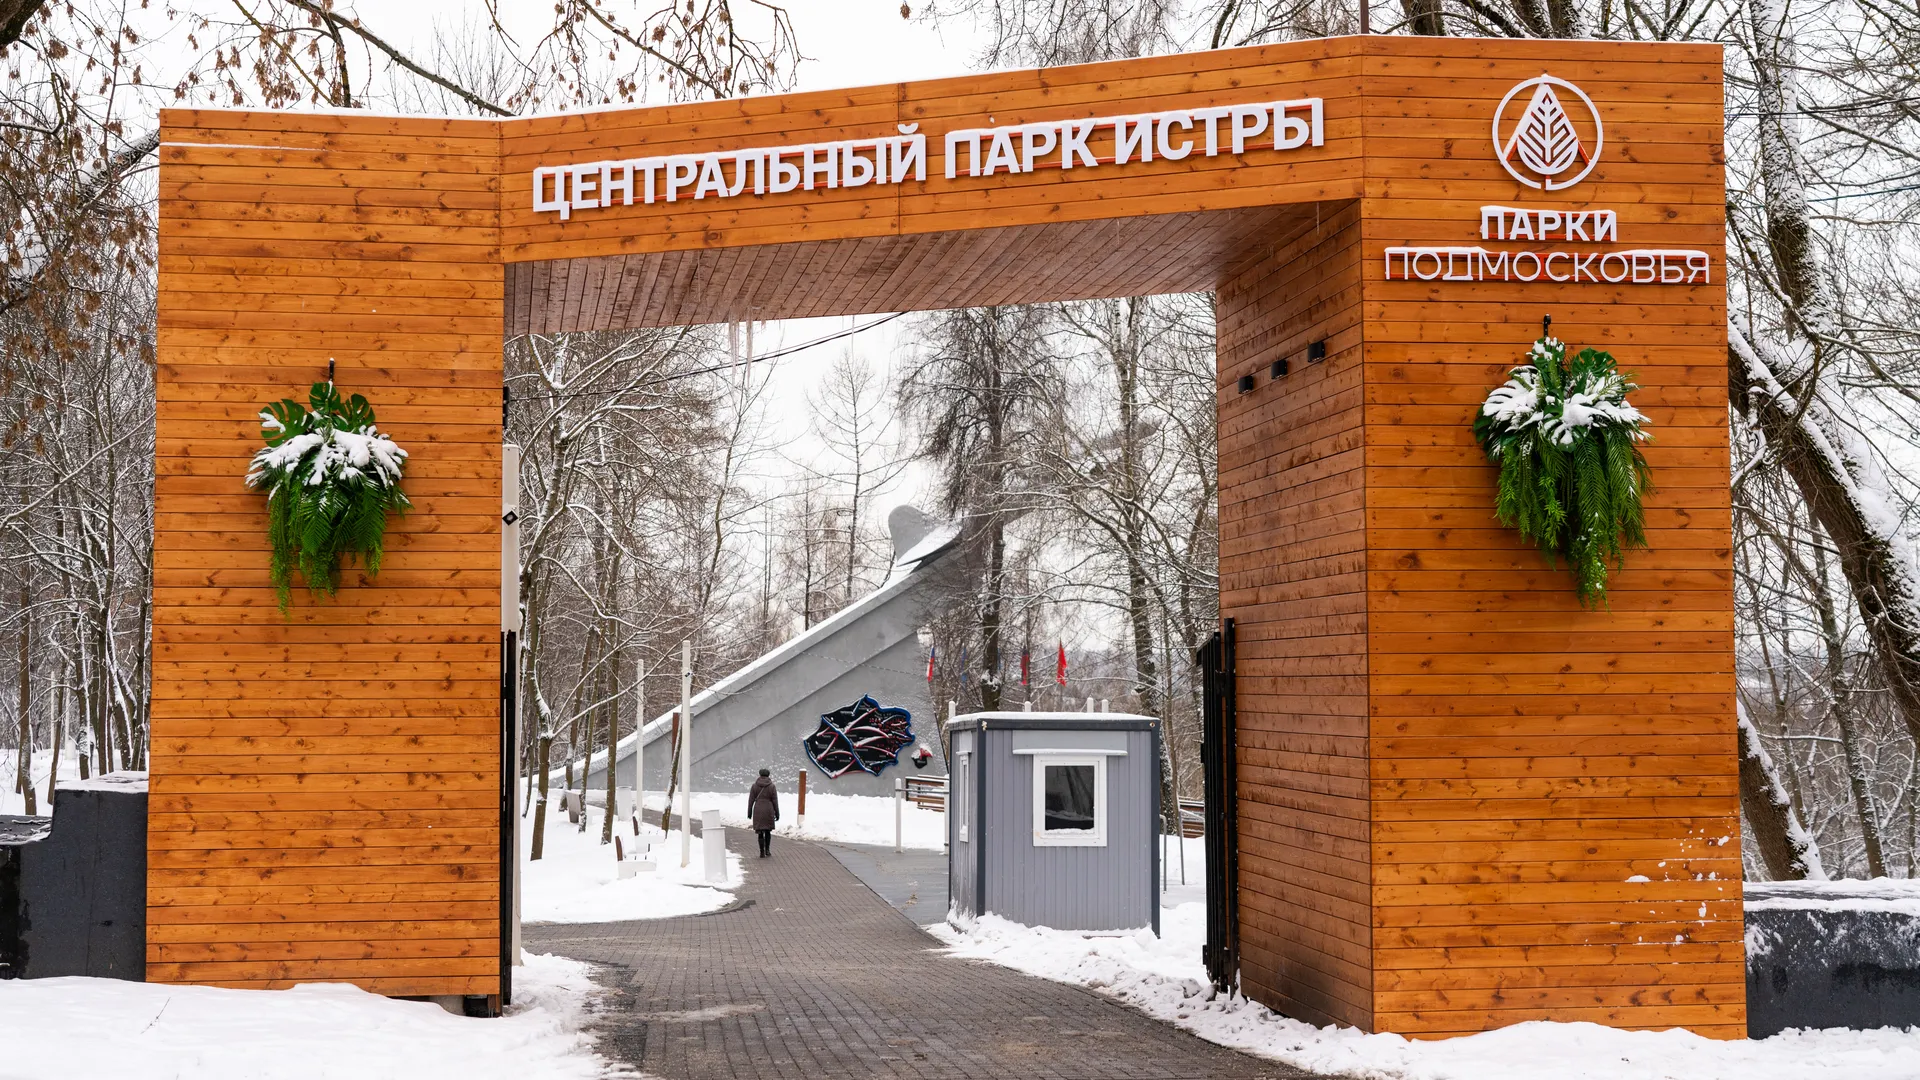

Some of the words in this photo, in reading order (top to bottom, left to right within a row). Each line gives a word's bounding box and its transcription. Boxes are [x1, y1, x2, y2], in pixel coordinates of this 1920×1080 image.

[533, 123, 926, 220] ЦЕНТРАЛЬНЫЙ
[945, 121, 1099, 179] ПАРК
[1115, 98, 1324, 164] ИСТРЫ
[1481, 207, 1617, 242] ПАРКИ
[1385, 248, 1710, 284] ПОДМОСКОВЬЯ
